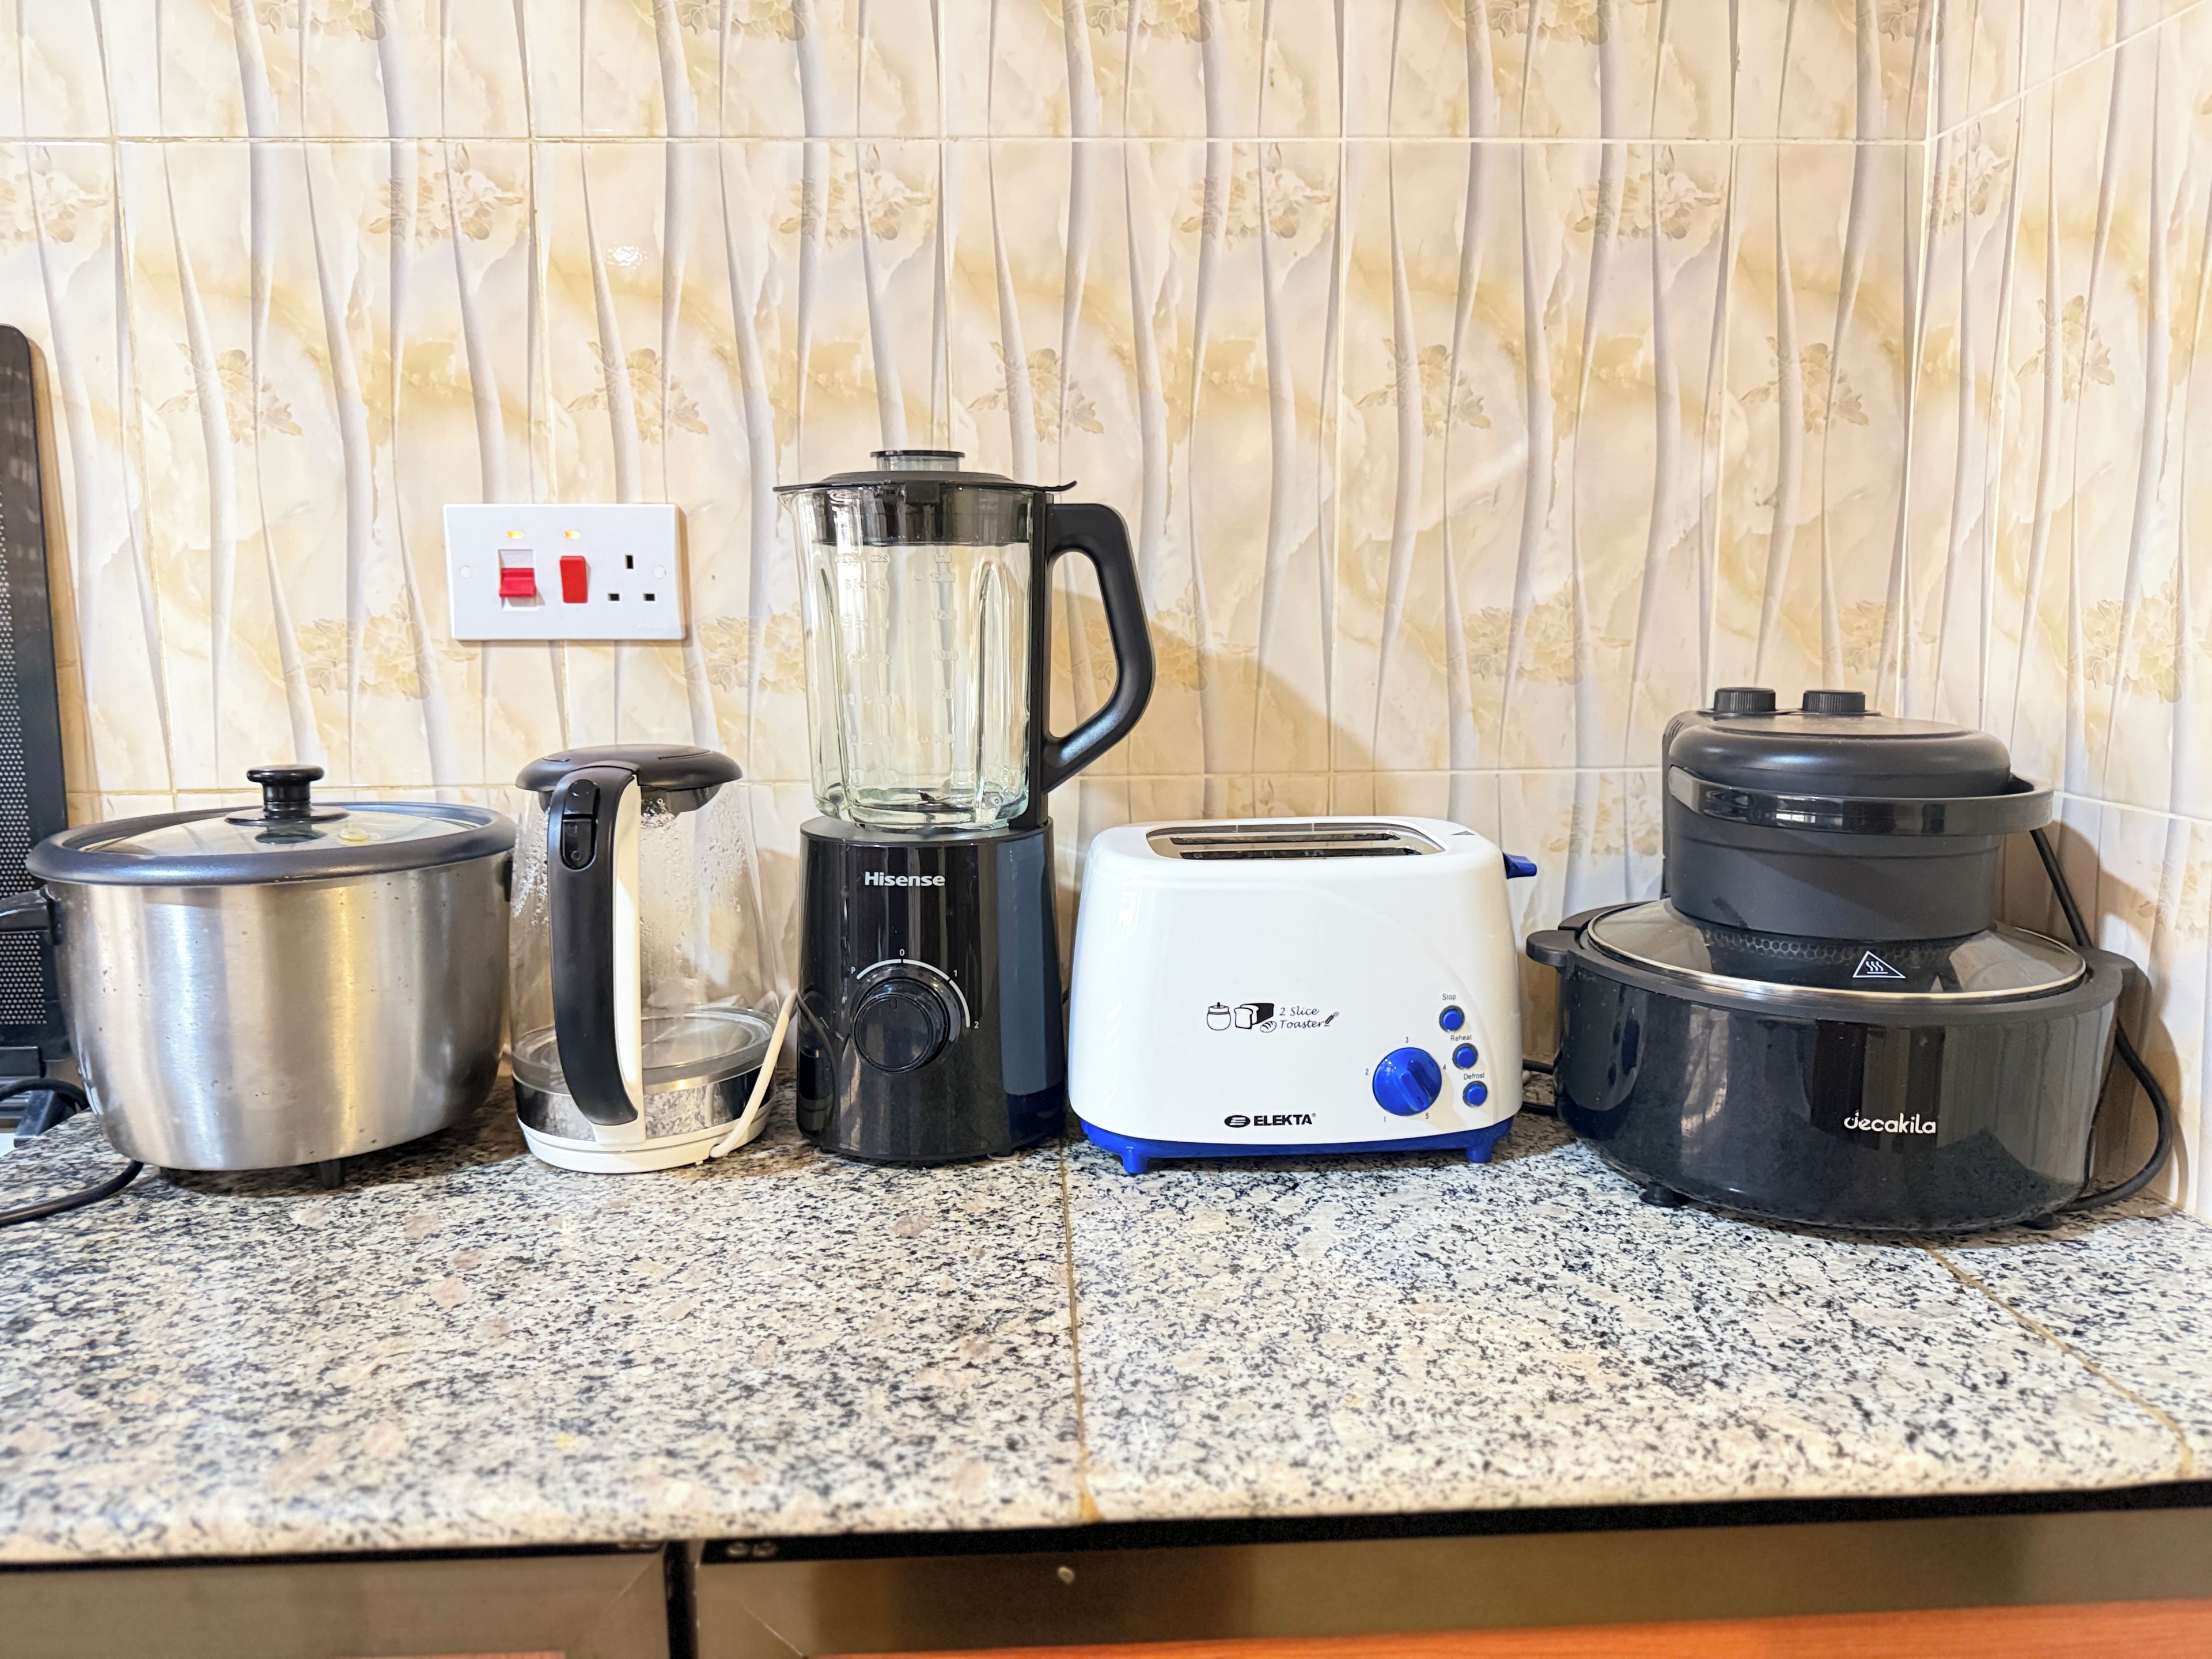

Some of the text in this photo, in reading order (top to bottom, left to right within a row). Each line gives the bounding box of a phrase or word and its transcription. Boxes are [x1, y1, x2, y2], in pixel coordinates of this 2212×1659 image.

[865, 872, 945, 887] Hisense
[851, 966, 856, 974] P
[1279, 1006, 1320, 1016] 2 Slice
[1279, 1019, 1325, 1029] Toaster
[1463, 1072, 1485, 1080] Defrost
[1844, 1109, 1936, 1134] decakila
